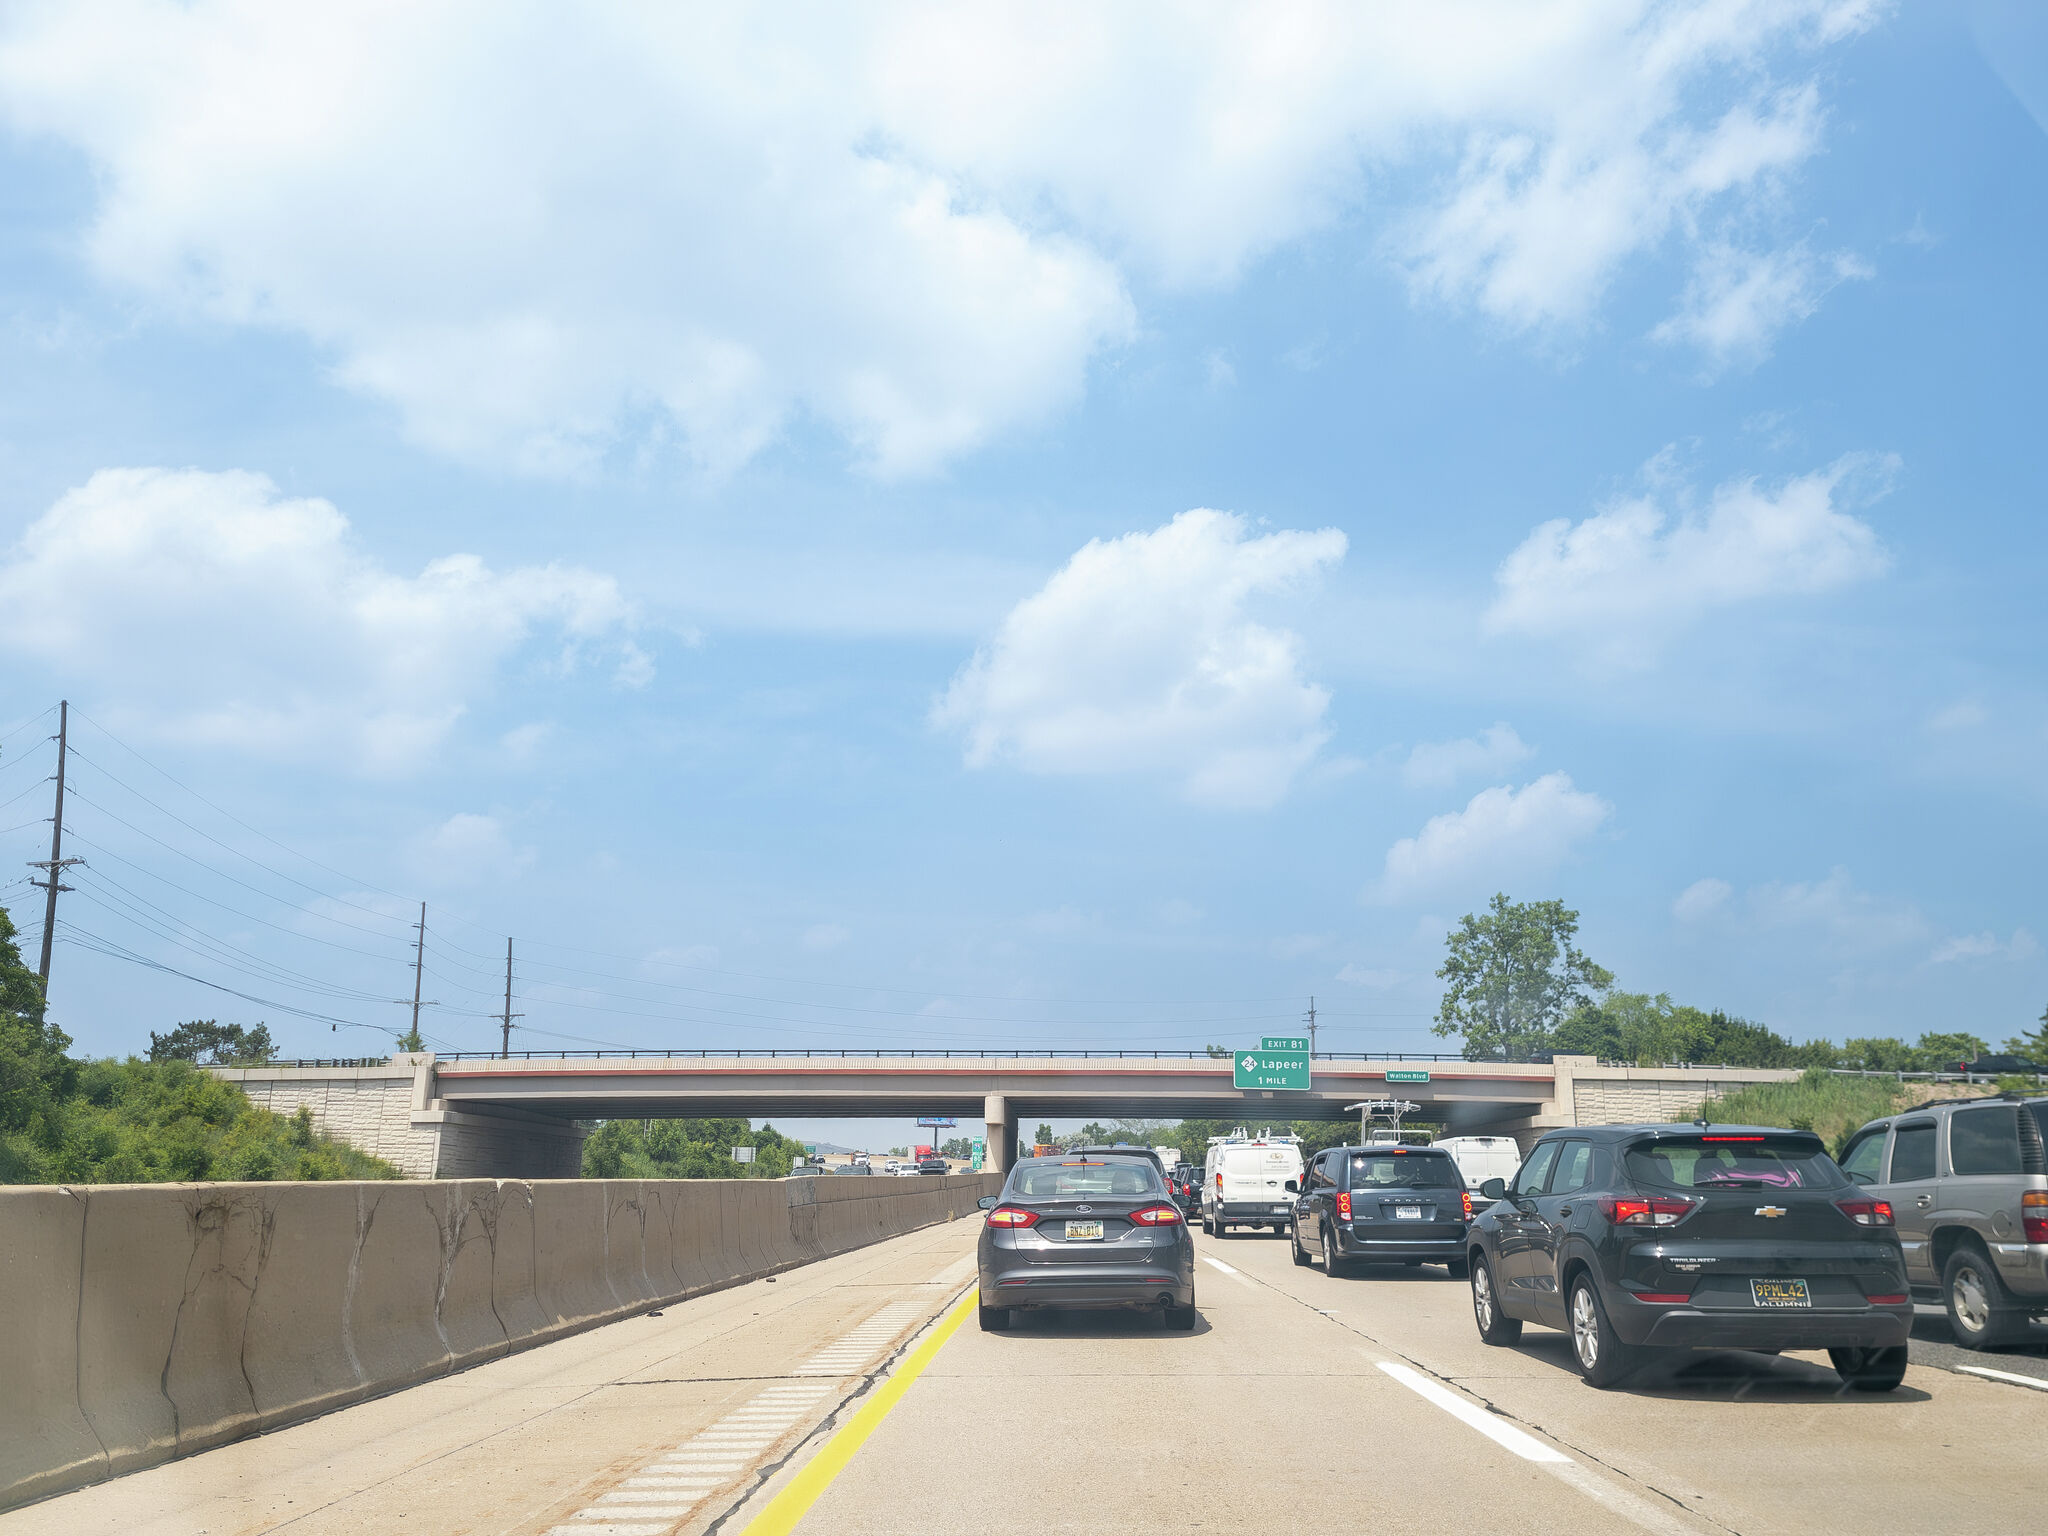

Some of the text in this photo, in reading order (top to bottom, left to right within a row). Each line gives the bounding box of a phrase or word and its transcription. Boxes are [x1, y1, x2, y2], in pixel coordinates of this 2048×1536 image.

[1268, 1040, 1303, 1049] EXIT 81
[1244, 1059, 1303, 1071] 24 Lapeer
[1258, 1076, 1287, 1085] 1 MILE
[1755, 1284, 1806, 1297] 9PML42
